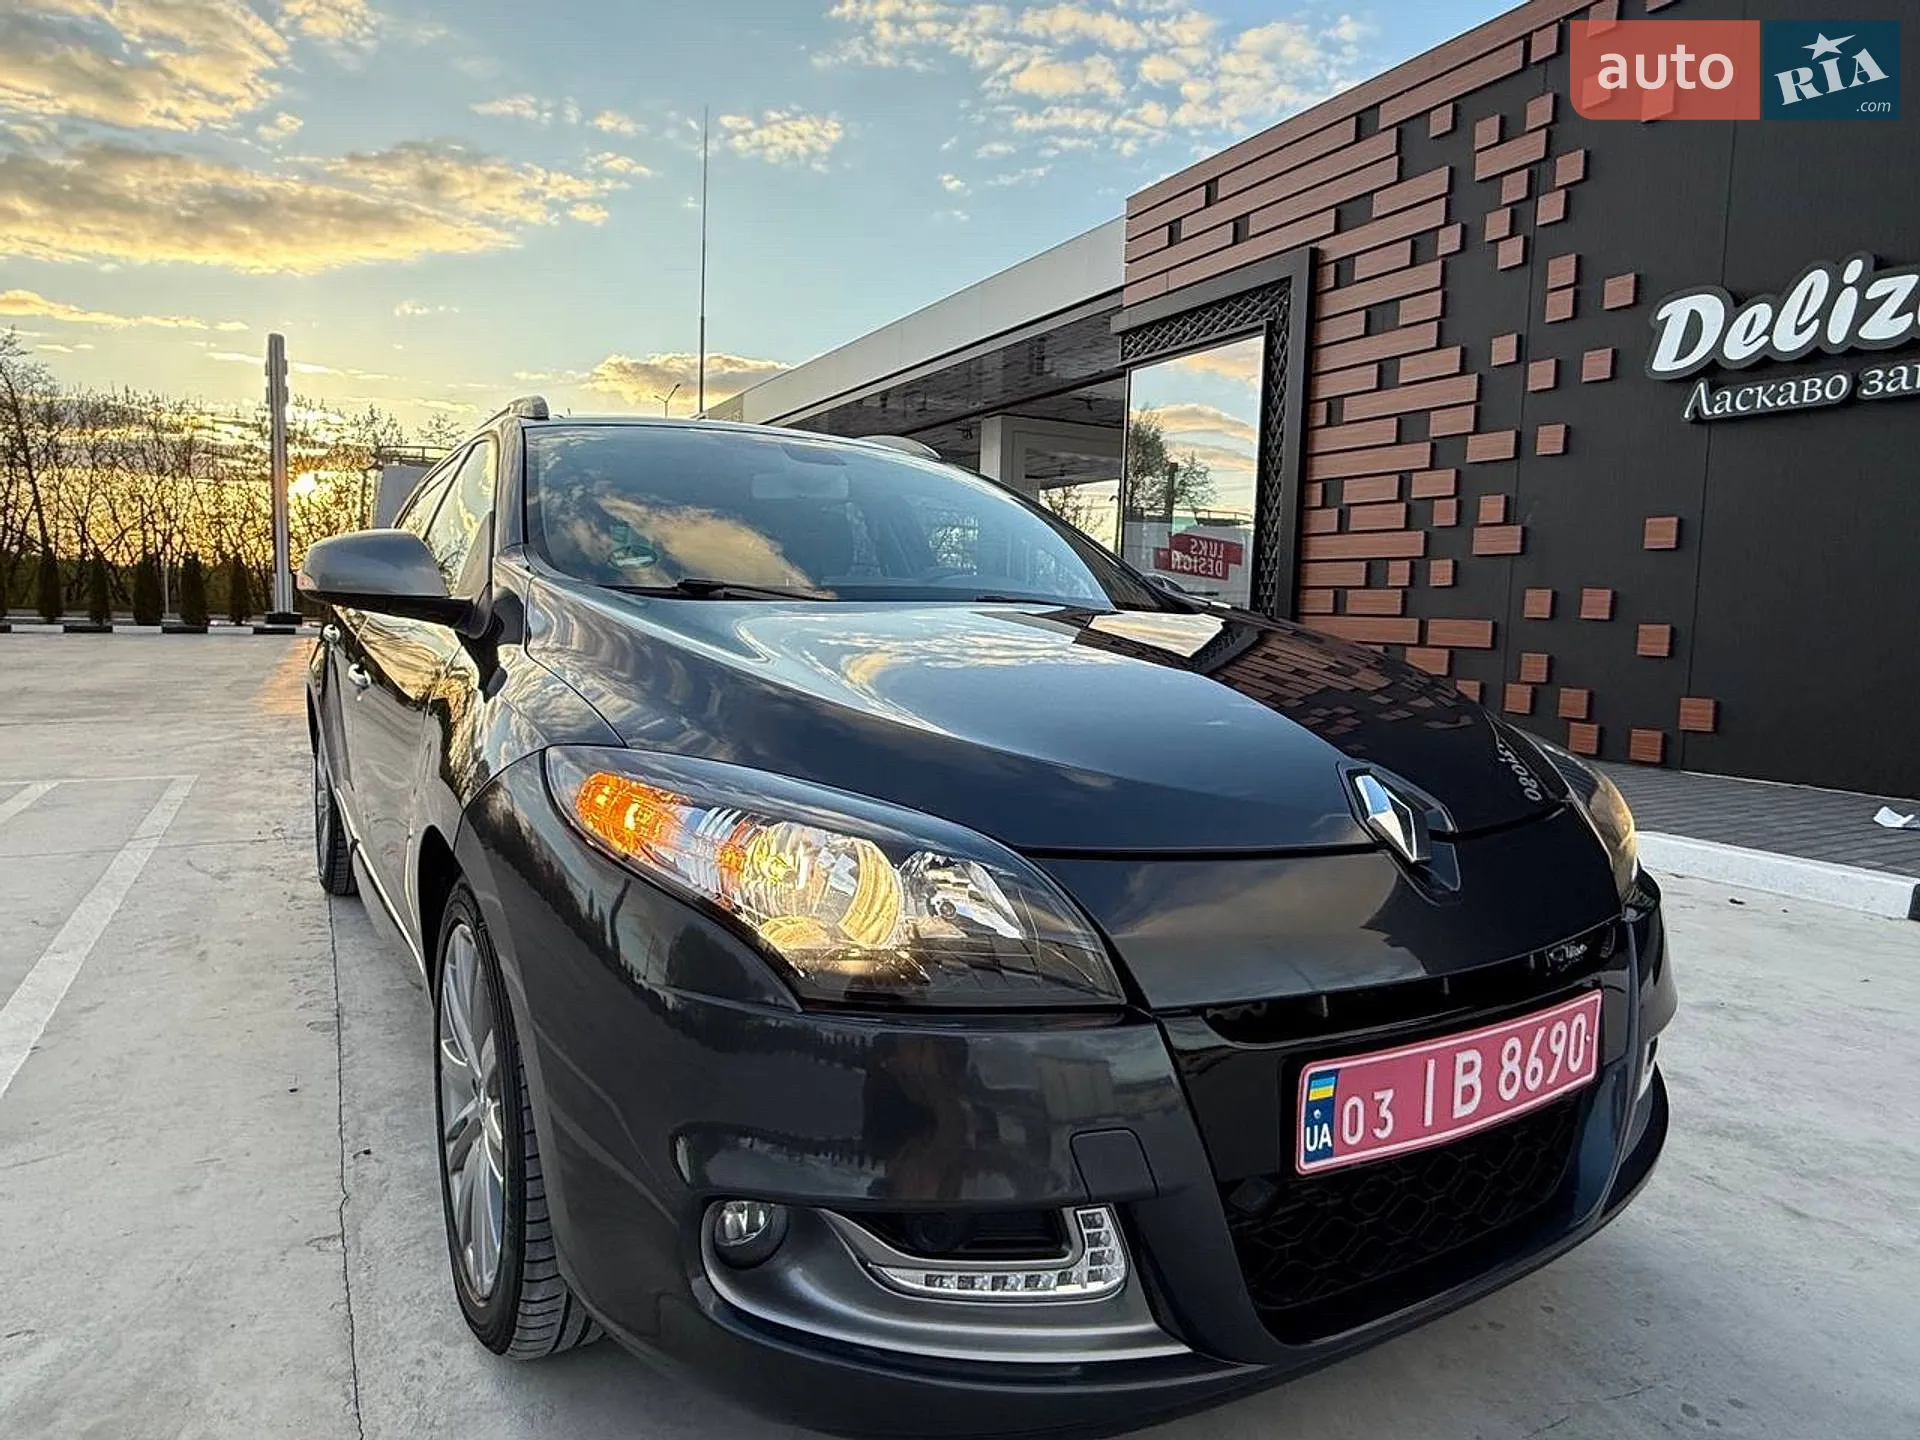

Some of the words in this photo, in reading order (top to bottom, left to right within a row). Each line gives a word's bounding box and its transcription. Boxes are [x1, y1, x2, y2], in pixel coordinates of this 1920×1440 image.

[1652, 259, 1920, 372] Deliz
[1684, 373, 1849, 418] Ласкаво
[1342, 1088, 1394, 1147] 03
[1423, 1048, 1483, 1128] IB
[1498, 1012, 1588, 1102] 8690
[1305, 1123, 1332, 1152] UA
